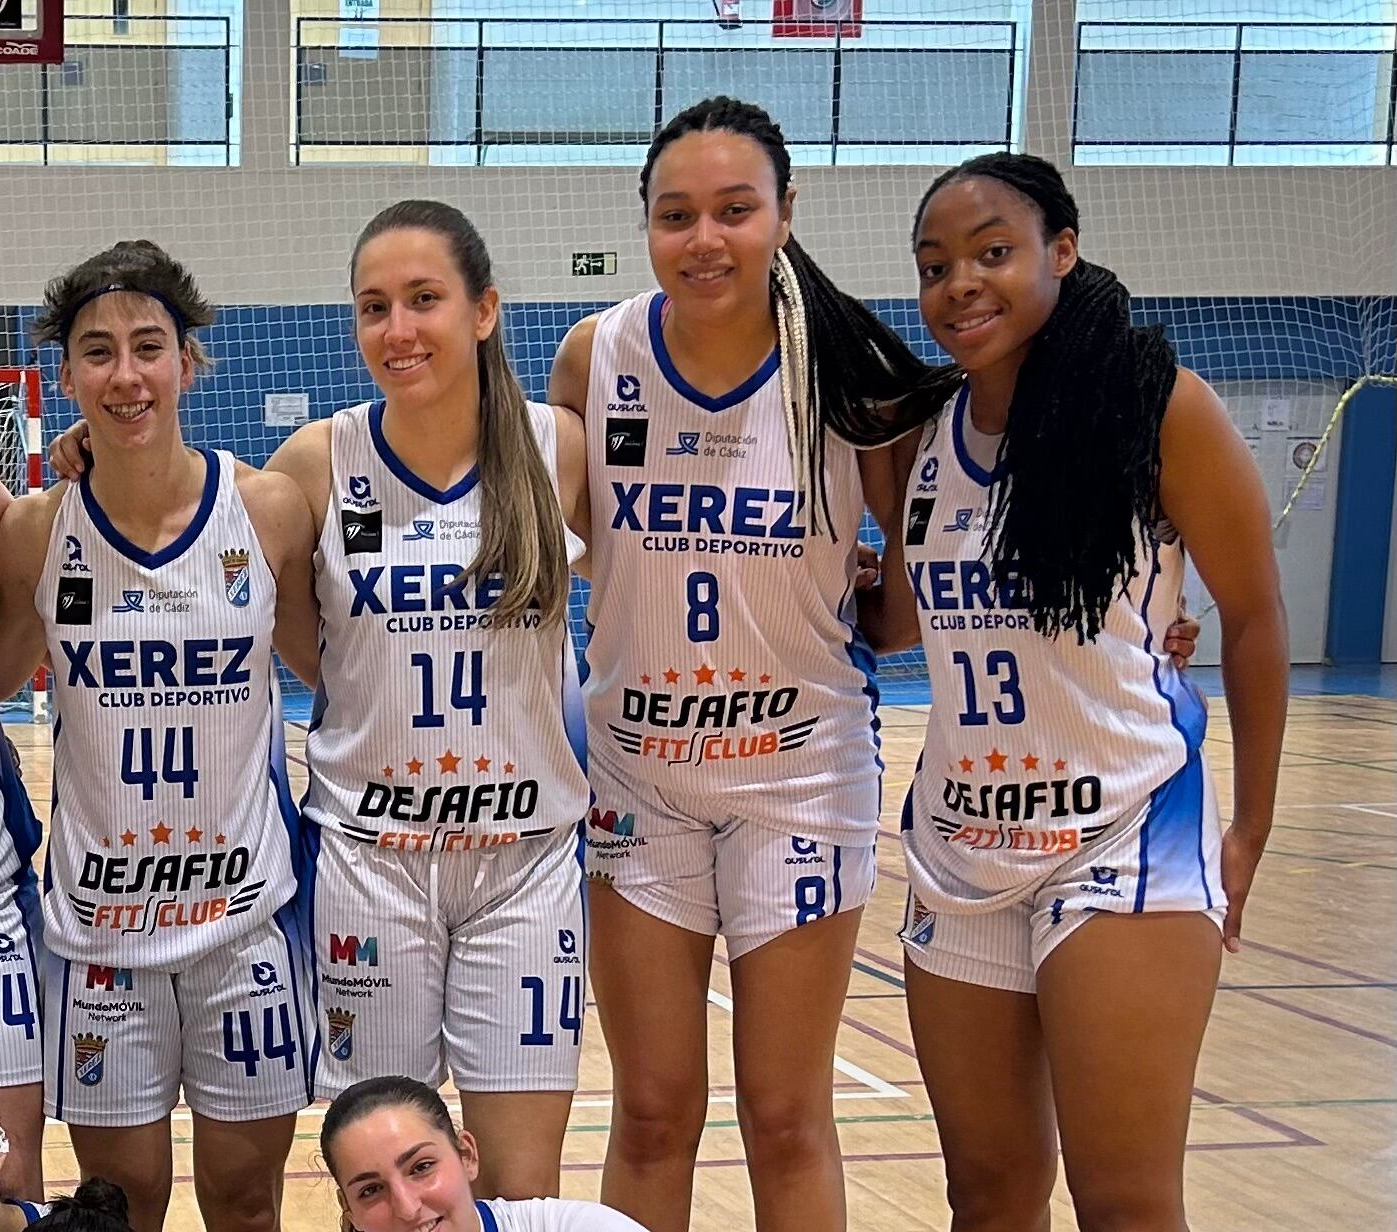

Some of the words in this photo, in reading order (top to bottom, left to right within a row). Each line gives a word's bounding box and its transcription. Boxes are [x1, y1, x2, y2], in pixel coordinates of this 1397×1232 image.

[703, 446, 717, 457] de
[719, 445, 747, 459] Cádiz
[704, 431, 758, 446] Diputación
[611, 481, 807, 540] XEREZ
[439, 530, 452, 541] de
[642, 536, 690, 553] CLUB
[695, 537, 805, 559] DEPORTIVO
[148, 588, 199, 603] Diputación
[149, 602, 162, 613] de
[164, 601, 190, 613] Cádiz
[687, 571, 720, 643] 8
[386, 615, 434, 634] CLUB
[930, 614, 967, 631] CLUB
[60, 635, 255, 689] XEREZ
[98, 691, 145, 708] CLUB
[151, 686, 251, 708] DEPORTIVO
[410, 650, 487, 728] 14
[622, 687, 799, 729] DESAFIO
[952, 649, 1027, 727] 13
[120, 726, 199, 801] 44
[642, 736, 690, 760] FIT
[703, 731, 780, 760] CLUB
[356, 779, 539, 824] DESAFIO
[942, 775, 1102, 822] DESAFIO
[78, 846, 250, 894] DESAFIO
[94, 904, 145, 929] FIT
[157, 897, 228, 928] CLUB
[520, 975, 581, 1046] 14
[223, 1001, 297, 1077] 44
